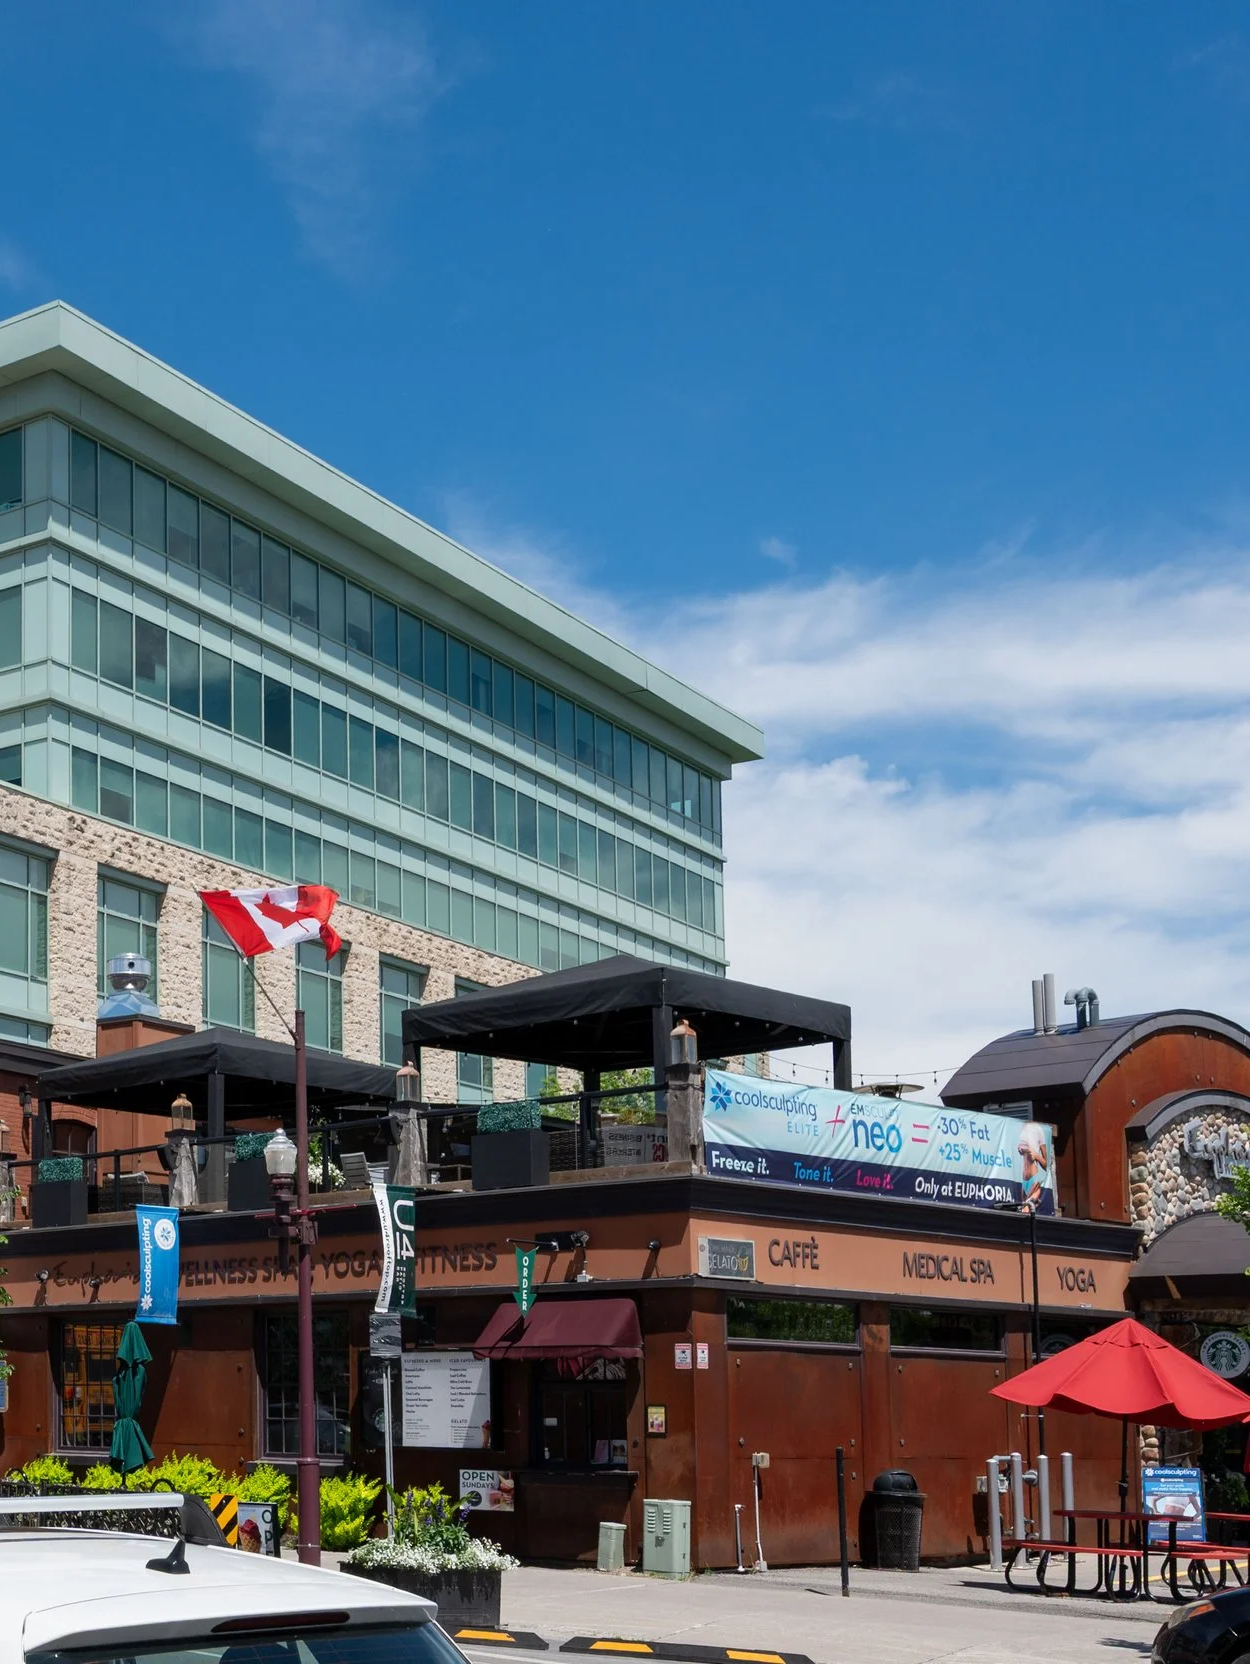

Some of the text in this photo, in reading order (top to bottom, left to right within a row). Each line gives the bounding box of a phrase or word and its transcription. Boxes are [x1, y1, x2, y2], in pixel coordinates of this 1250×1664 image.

[734, 1090, 817, 1121] coolsculpting
[787, 1121, 819, 1137] ELITE
[853, 1118, 902, 1153] neo
[970, 1121, 990, 1141] Fat
[711, 1150, 770, 1175] Freeze it.
[793, 1161, 834, 1183] Tone it.
[972, 1150, 1012, 1168] Muscle
[856, 1169, 880, 1188] Love
[915, 1176, 939, 1198] Only
[941, 1182, 952, 1196] at
[394, 1199, 415, 1260] U4
[143, 1218, 152, 1294] coolsculpting
[321, 1250, 382, 1279] YOGA
[415, 1243, 497, 1275] ITNESS
[768, 1236, 820, 1270] CAFFÈ
[903, 1251, 995, 1284] MEDICAL SPA
[1056, 1266, 1097, 1293] YOGA
[462, 1471, 494, 1481] OPEN
